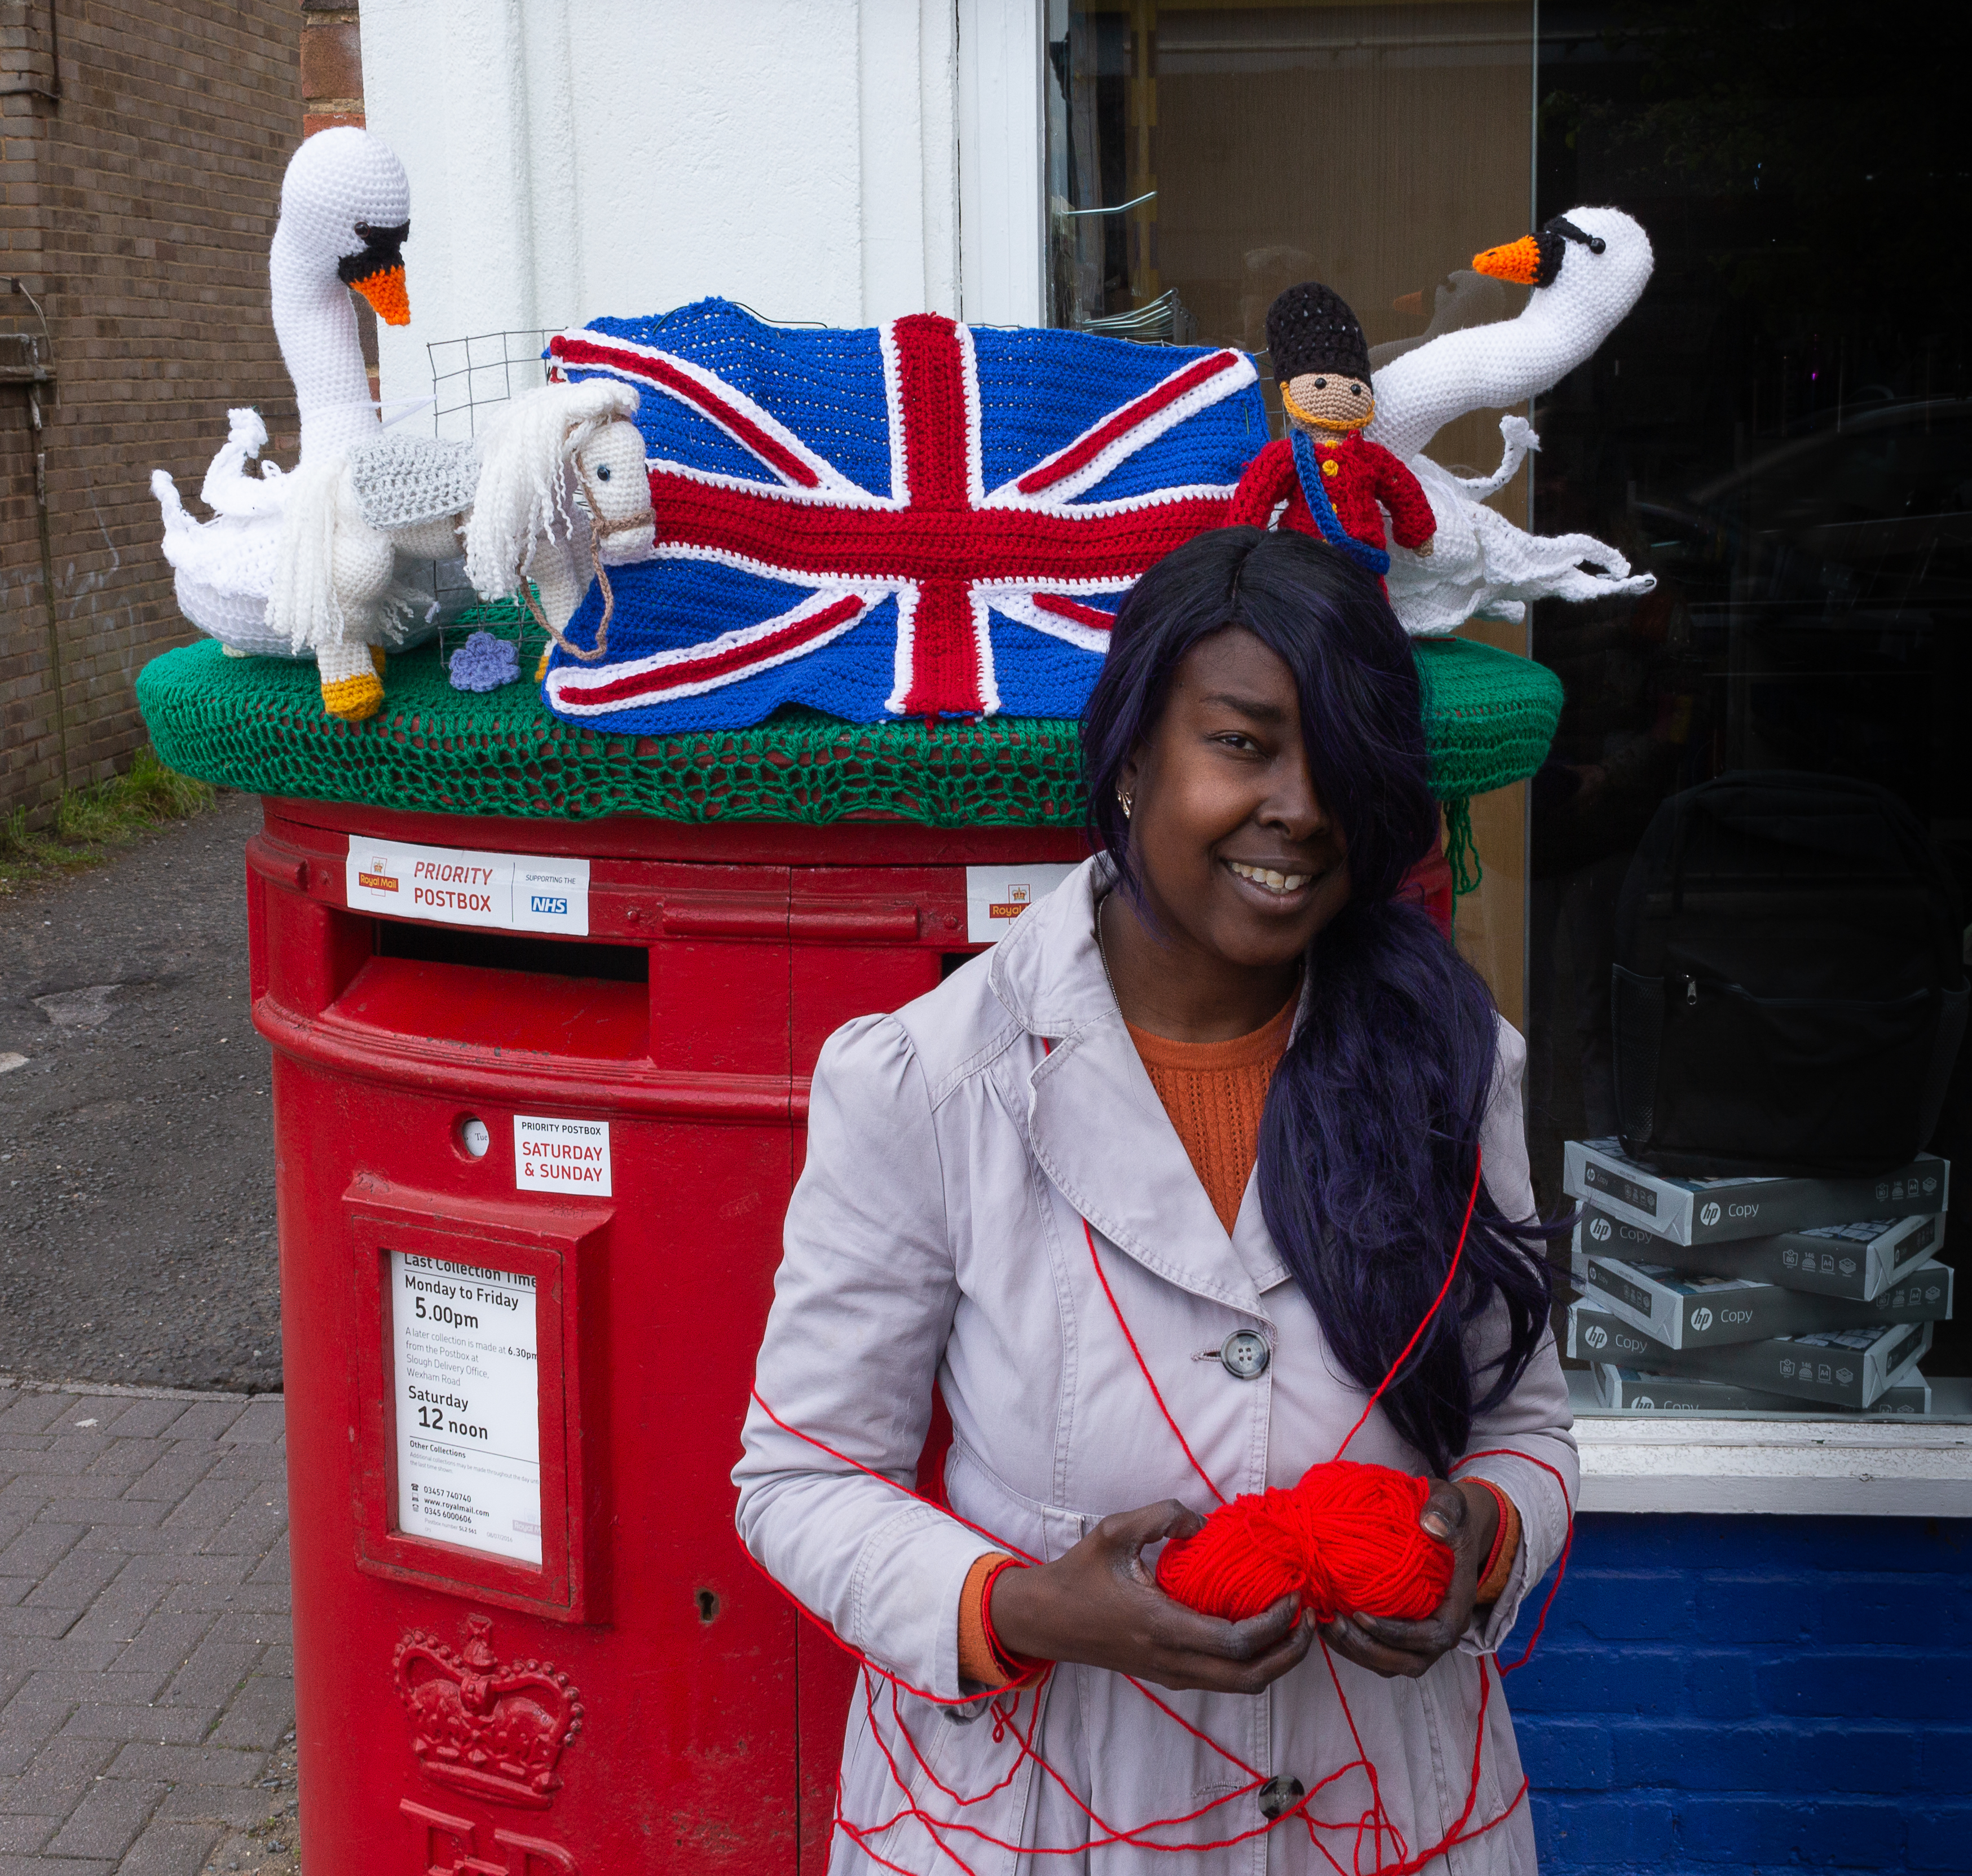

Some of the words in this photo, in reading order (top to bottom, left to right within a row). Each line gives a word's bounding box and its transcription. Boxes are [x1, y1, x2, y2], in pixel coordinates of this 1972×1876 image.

[360, 874, 380, 886] Royal
[381, 879, 396, 889] Mail
[414, 861, 493, 885] PRIORITY
[526, 875, 563, 883] SUPPORTING
[414, 887, 491, 912] POSTBOX
[532, 897, 566, 913] NHS
[992, 906, 1021, 916] Royal
[522, 1122, 559, 1133] PRIORITY
[562, 1125, 601, 1135] POSTBOX
[522, 1141, 602, 1161] SATURDAY
[524, 1162, 535, 1177] &
[540, 1164, 602, 1182] SUNDAY
[1700, 1202, 1721, 1226] hp
[1728, 1203, 1759, 1218] Copy
[1590, 1218, 1612, 1241] hp
[1620, 1226, 1653, 1244] Copy
[404, 1253, 433, 1269] Last
[436, 1259, 501, 1281] Collection
[405, 1274, 456, 1299] Monday
[460, 1286, 473, 1300] to
[477, 1288, 519, 1310] Friday
[416, 1296, 478, 1328] 5.00pm
[1691, 1308, 1713, 1331] hp
[1720, 1309, 1753, 1324] Copy
[405, 1327, 411, 1336] A
[413, 1328, 429, 1339] later
[431, 1333, 466, 1347] collection
[468, 1339, 474, 1348] is
[476, 1342, 497, 1353] made
[1585, 1326, 1607, 1349] hp
[1615, 1334, 1648, 1353] Copy
[406, 1340, 424, 1352] from
[426, 1345, 438, 1354] the
[440, 1347, 470, 1361] Postbox
[407, 1353, 433, 1367] Slough
[434, 1359, 465, 1375] Delivery
[407, 1367, 440, 1382] Wexham
[442, 1374, 461, 1386] Road
[408, 1385, 468, 1412] Saturday
[418, 1406, 443, 1430] 12
[449, 1420, 488, 1440] noon
[410, 1440, 428, 1450] Other
[430, 1445, 466, 1458] Collections
[433, 1457, 456, 1467] collections
[423, 1486, 444, 1497] 03457
[446, 1490, 471, 1502] 740740
[424, 1498, 489, 1517] www.royalmail.com
[425, 1507, 441, 1517] 0345
[443, 1511, 471, 1523] 6000606
